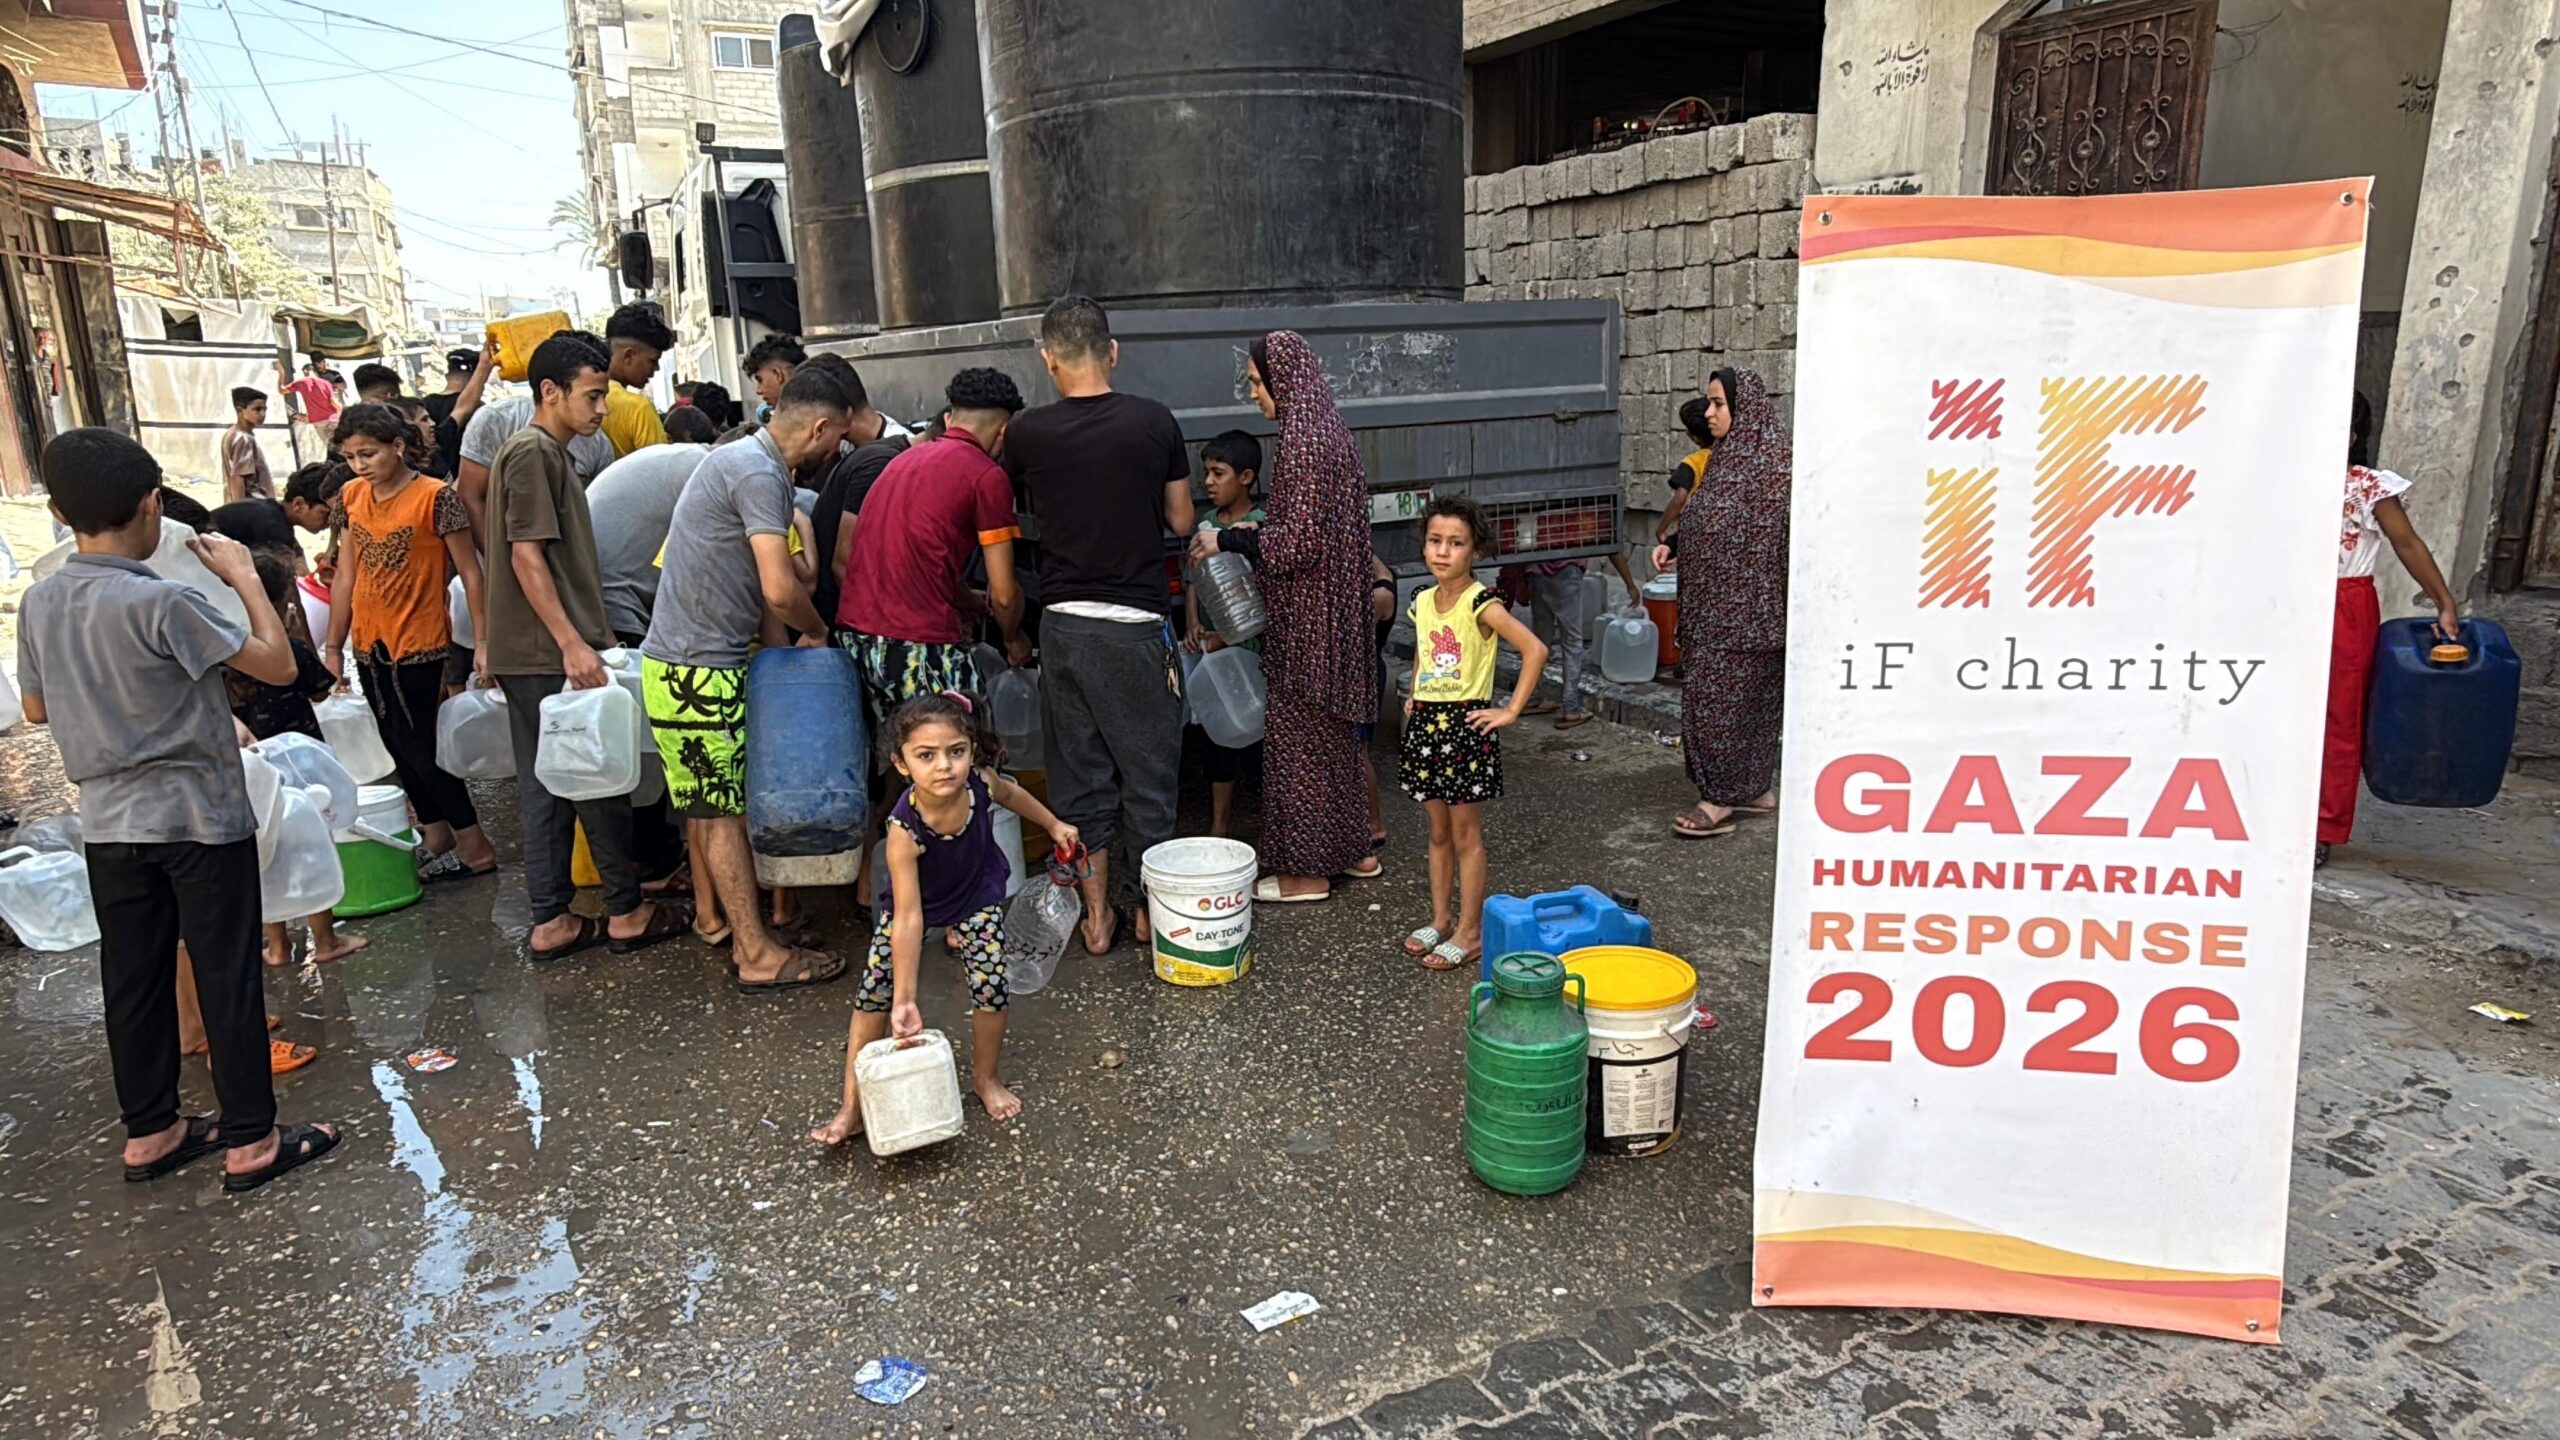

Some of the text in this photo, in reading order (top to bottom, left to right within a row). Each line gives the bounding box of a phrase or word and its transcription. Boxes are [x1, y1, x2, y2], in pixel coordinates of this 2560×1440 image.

[1839, 637, 2266, 706] iF charity
[1814, 753, 2249, 842] GAZA
[1214, 890, 1245, 911] GLC
[1812, 858, 2243, 898] HUMANITARIAN
[1809, 911, 2248, 968] RESPONSE
[1804, 972, 2241, 1083] 2026
